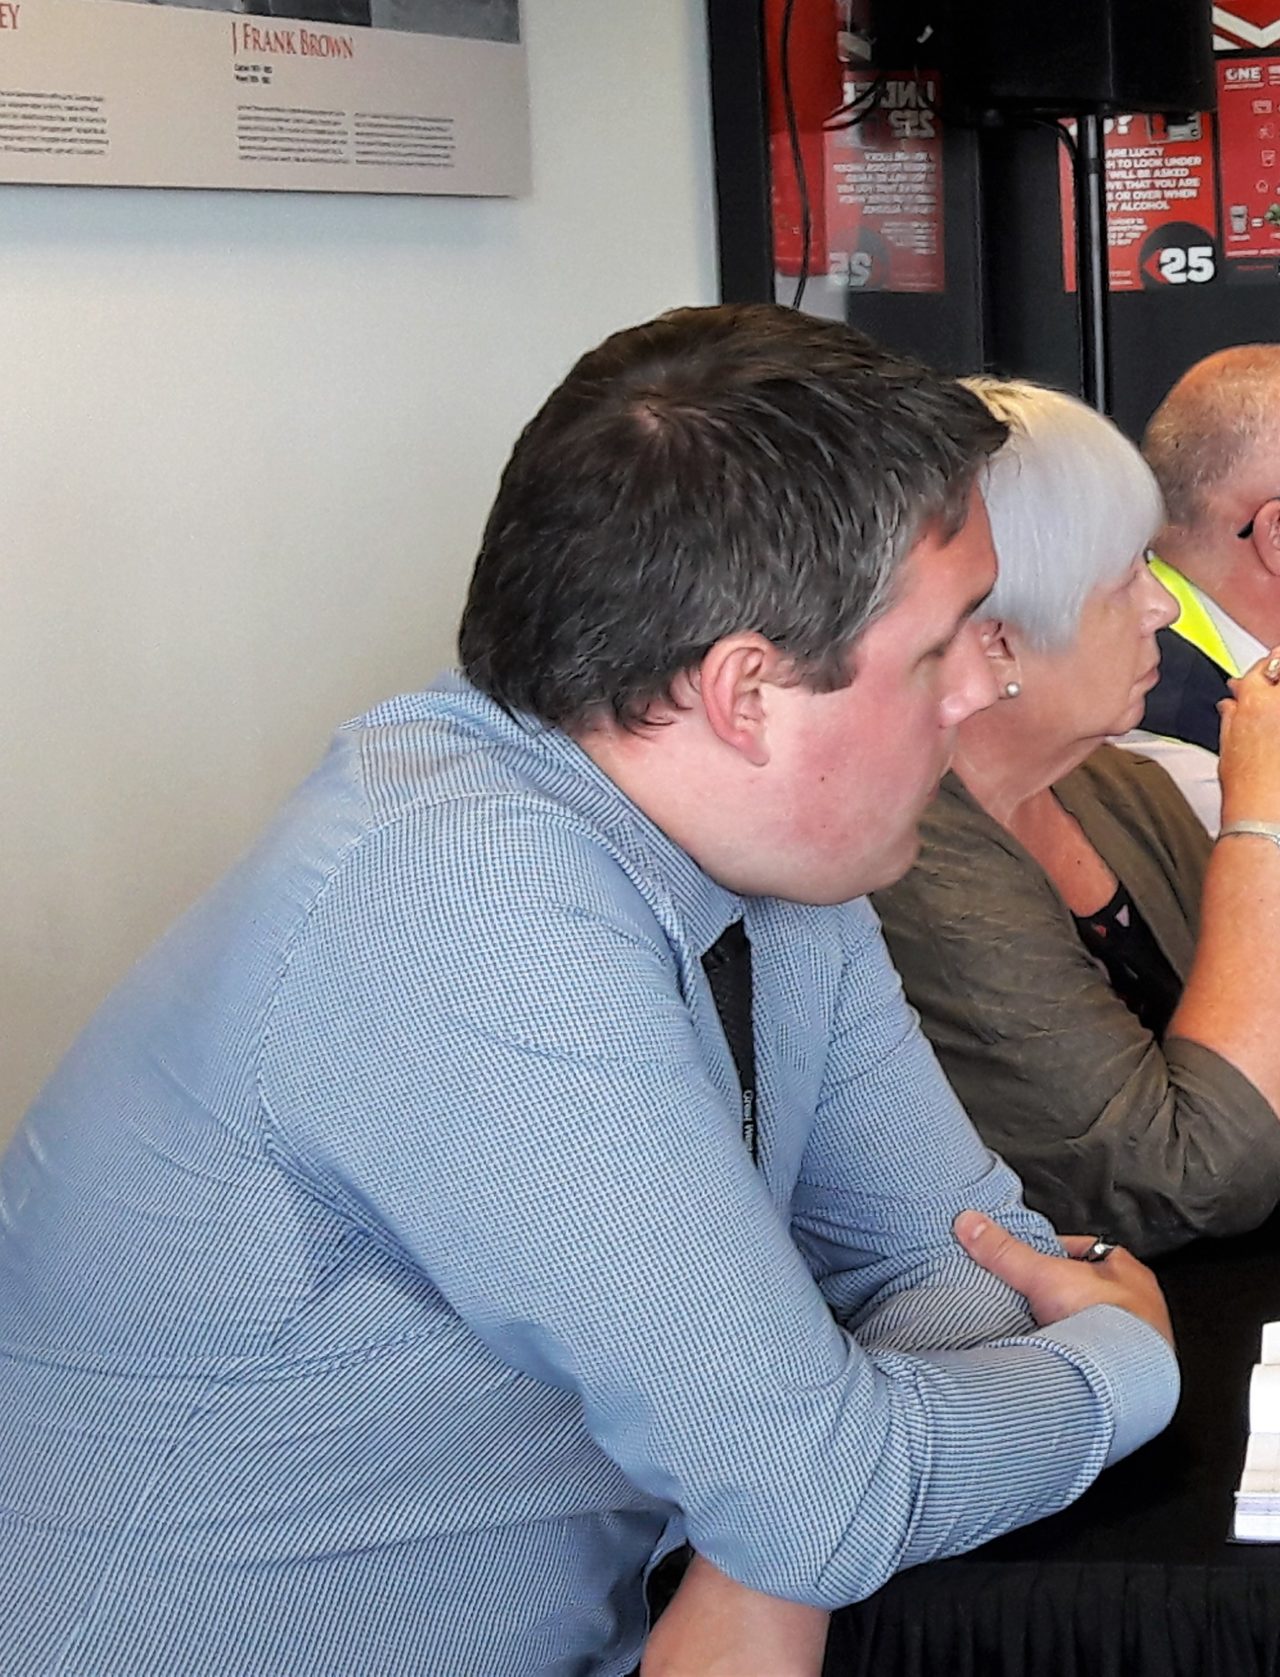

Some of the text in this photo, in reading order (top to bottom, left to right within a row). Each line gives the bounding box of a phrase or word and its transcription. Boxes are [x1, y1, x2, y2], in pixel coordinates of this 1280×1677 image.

[243, 22, 296, 55] FRANK
[300, 28, 353, 59] BROWN
[1128, 147, 1164, 158] LUCKY
[1117, 160, 1132, 169] TO
[1133, 158, 1163, 168] LOOK
[1125, 180, 1151, 190] THAT
[1153, 179, 1177, 188] YOU
[1178, 178, 1201, 187] ARE
[1115, 191, 1131, 200] OR
[1132, 190, 1162, 199] OVER
[1163, 188, 1198, 198] WHEN
[1120, 200, 1170, 211] ALCOHOL
[1160, 246, 1215, 284] 25
